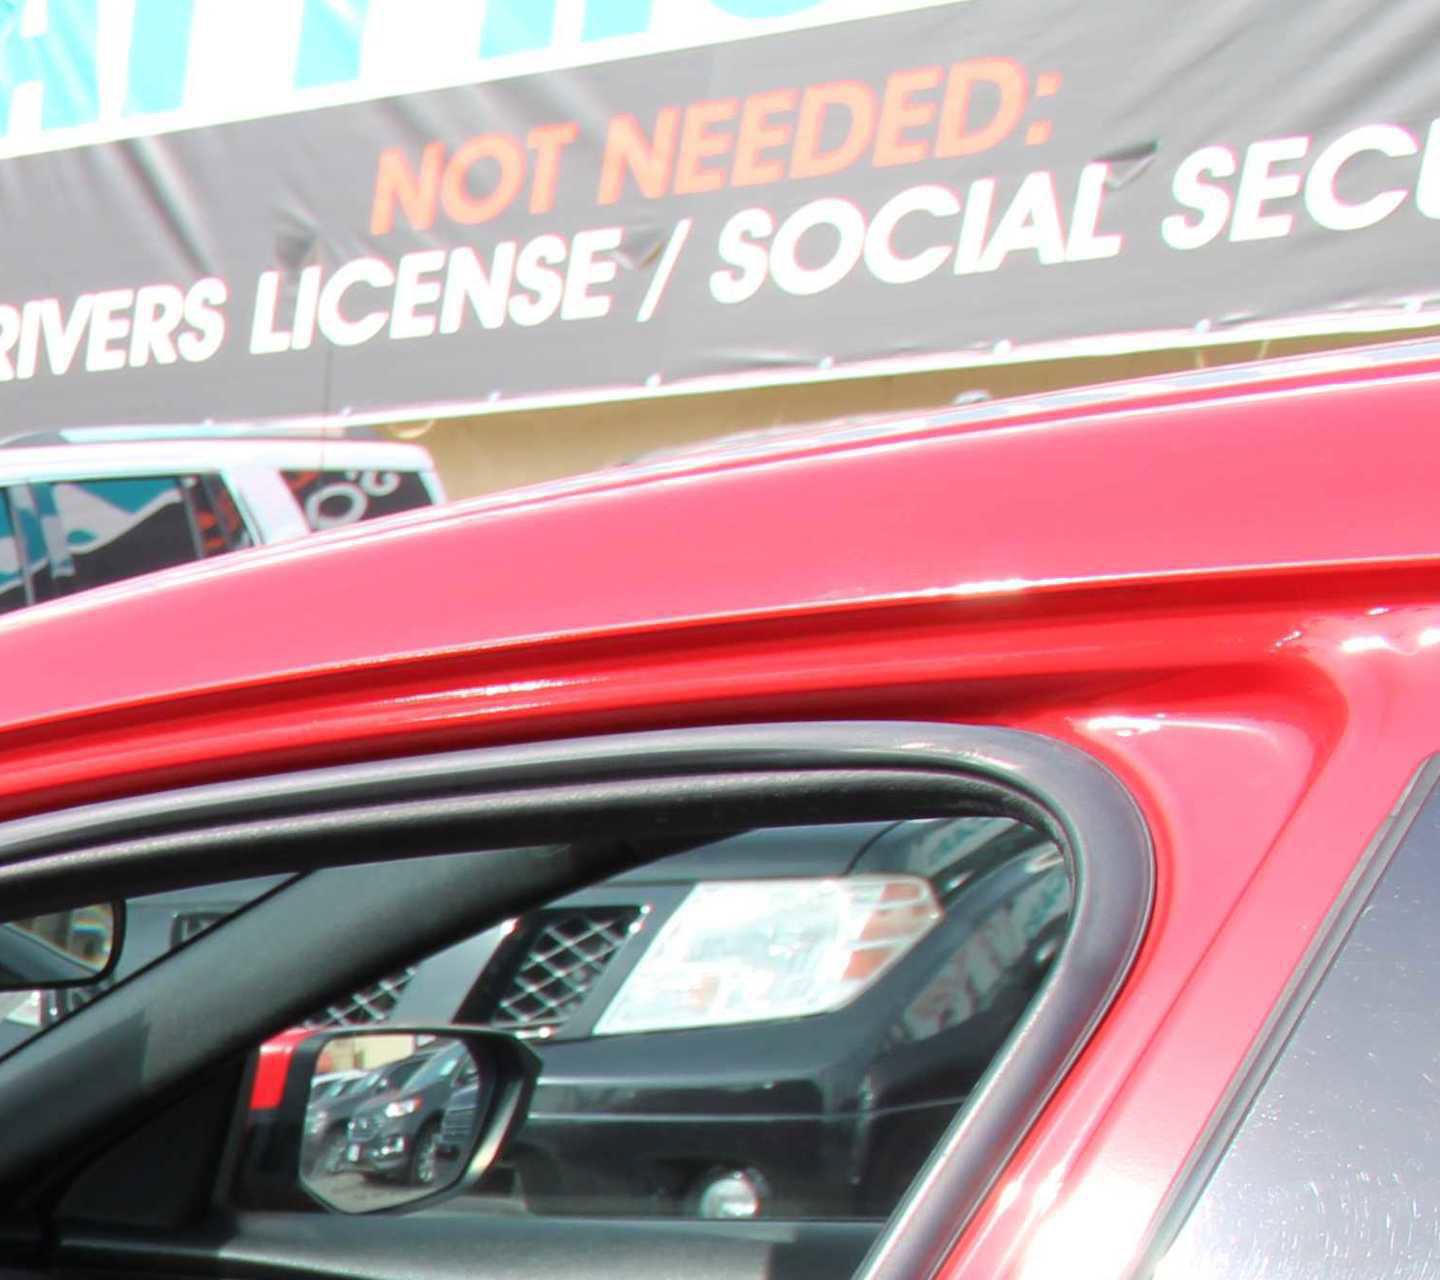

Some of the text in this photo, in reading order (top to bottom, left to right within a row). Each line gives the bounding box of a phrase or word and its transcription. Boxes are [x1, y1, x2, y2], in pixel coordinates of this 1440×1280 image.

[371, 123, 579, 236] NOT
[597, 56, 1062, 206] NEEDED:
[250, 227, 624, 355] LICENSE
[709, 163, 1124, 304] SOCIAL
